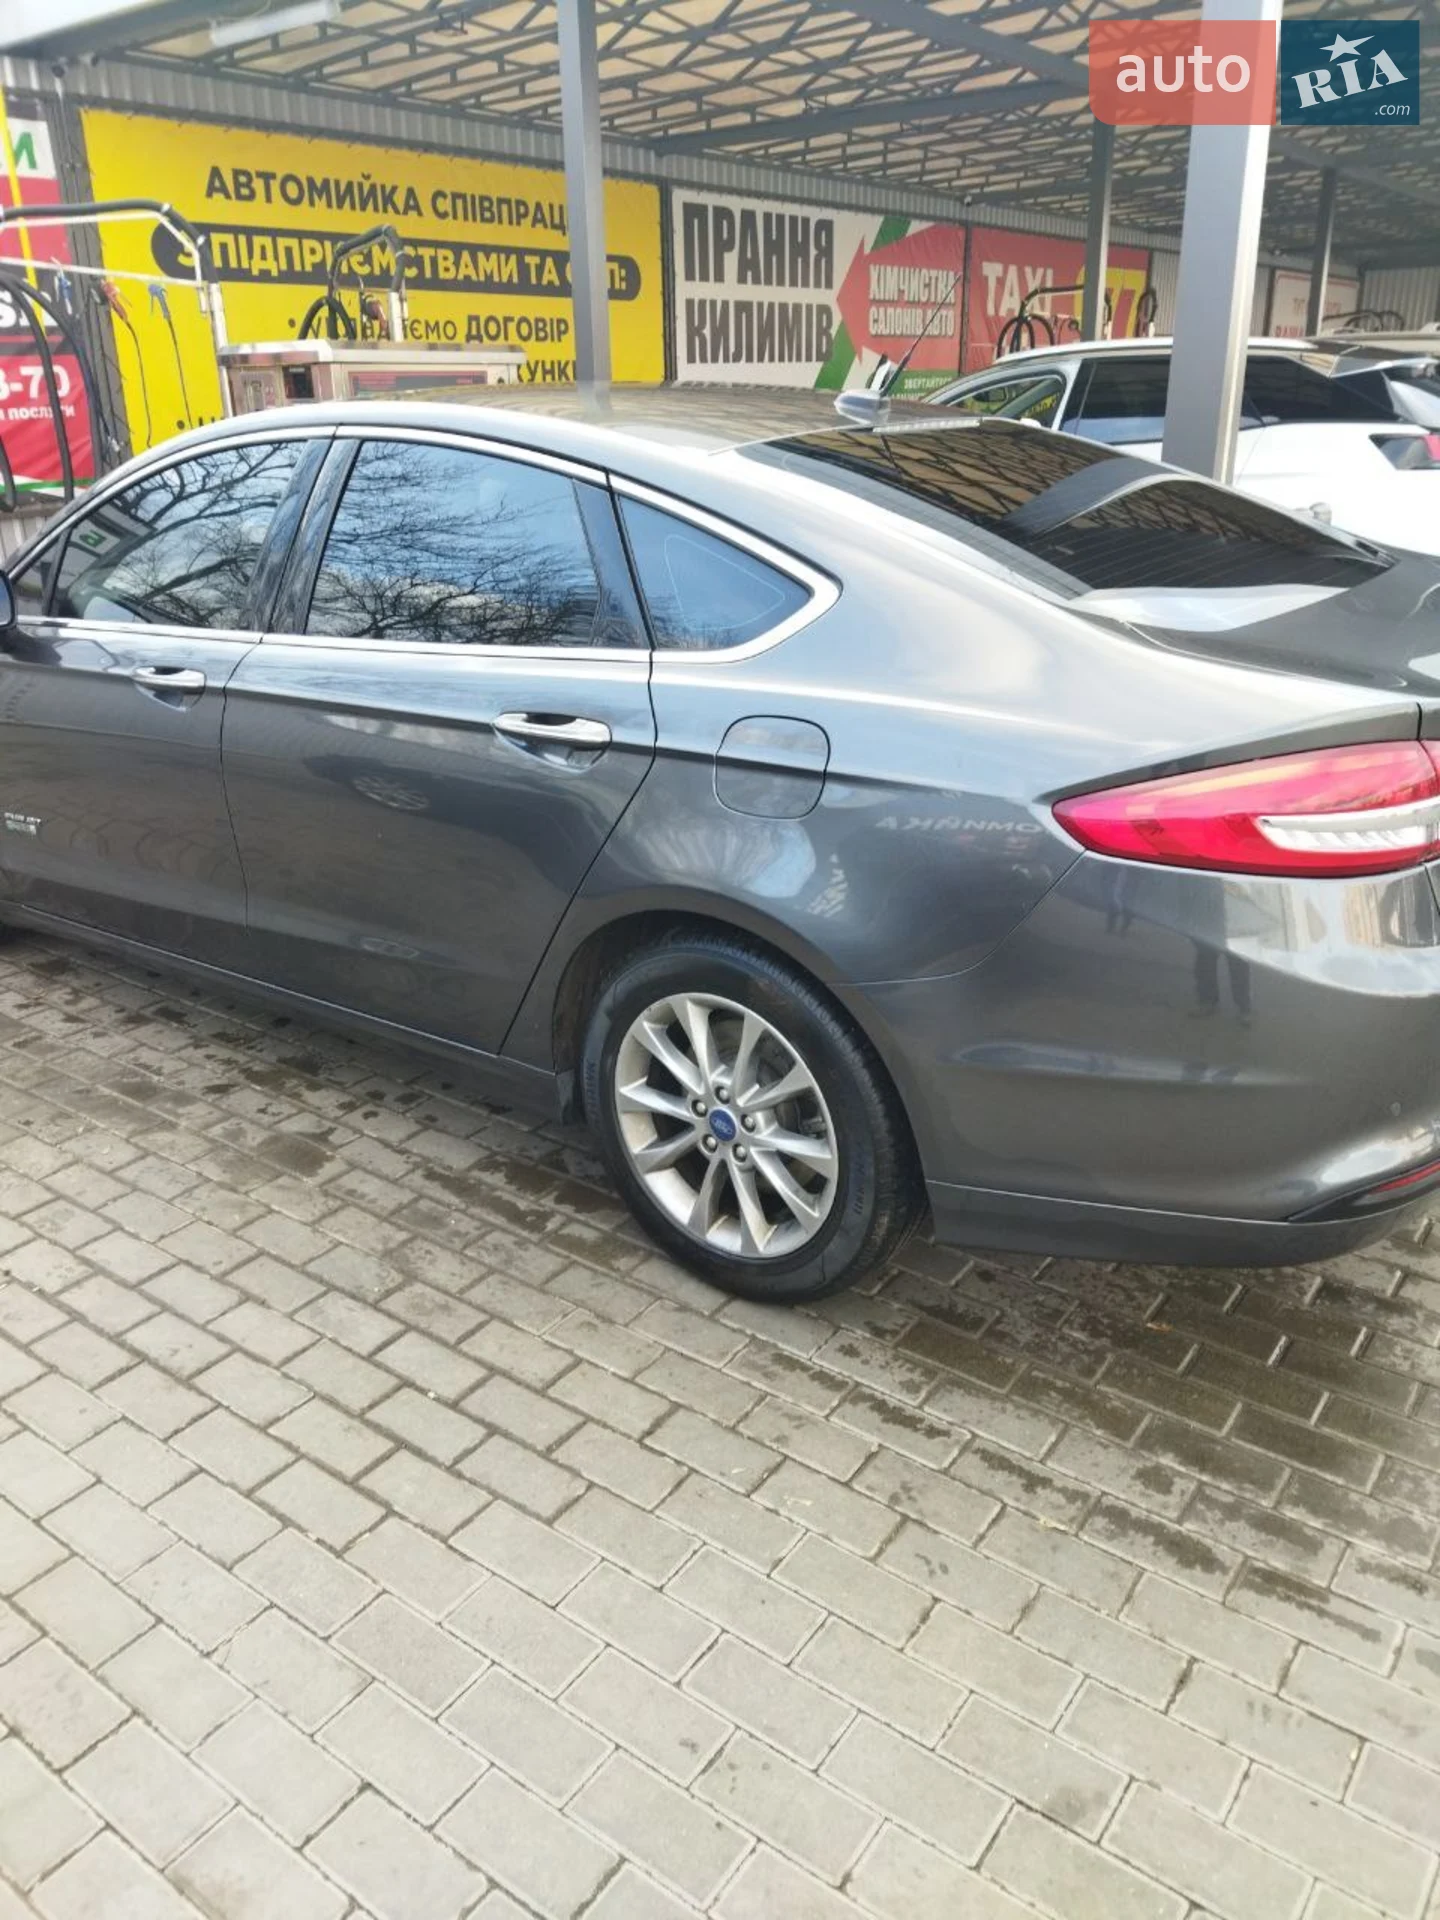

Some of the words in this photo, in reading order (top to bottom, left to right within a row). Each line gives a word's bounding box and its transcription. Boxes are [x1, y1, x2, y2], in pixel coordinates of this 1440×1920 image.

[205, 166, 423, 218] АВТОМИЙКА
[431, 190, 568, 237] СПІВПРАЦ
[682, 201, 835, 290] ПРАННЯ
[524, 255, 561, 288] ТА
[869, 264, 956, 304] ХІМЧИСТКА
[465, 314, 569, 344] ДОГОВІР
[684, 297, 834, 365] КИЛИМІВ
[869, 306, 924, 336] САЛОНІВ
[923, 310, 955, 337] АВТО
